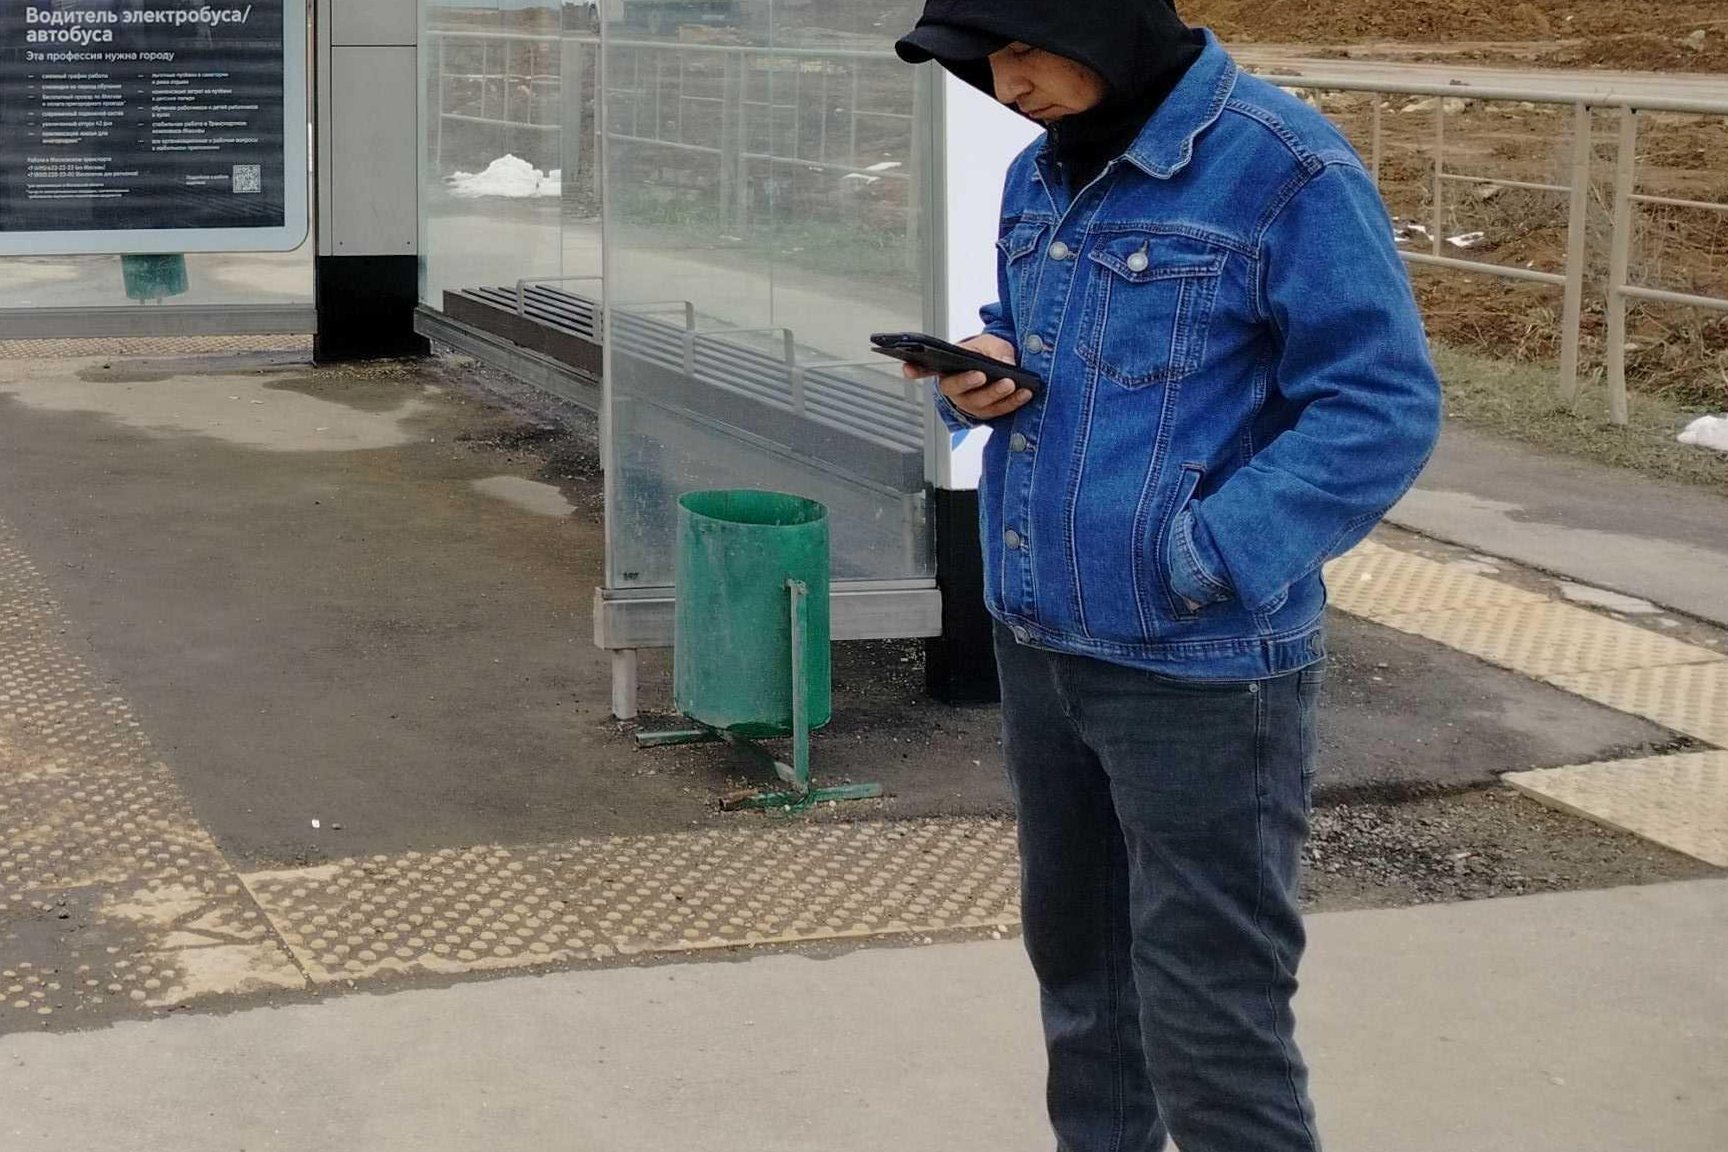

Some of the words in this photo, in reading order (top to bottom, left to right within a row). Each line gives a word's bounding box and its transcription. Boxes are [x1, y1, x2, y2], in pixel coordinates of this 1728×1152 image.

[26, 6, 118, 25] Водитель
[122, 5, 252, 26] электробуса/
[26, 25, 113, 46] автобуса
[26, 51, 44, 61] Эта
[46, 50, 103, 62] профессия
[105, 52, 137, 61] нужна
[139, 51, 175, 61] городу
